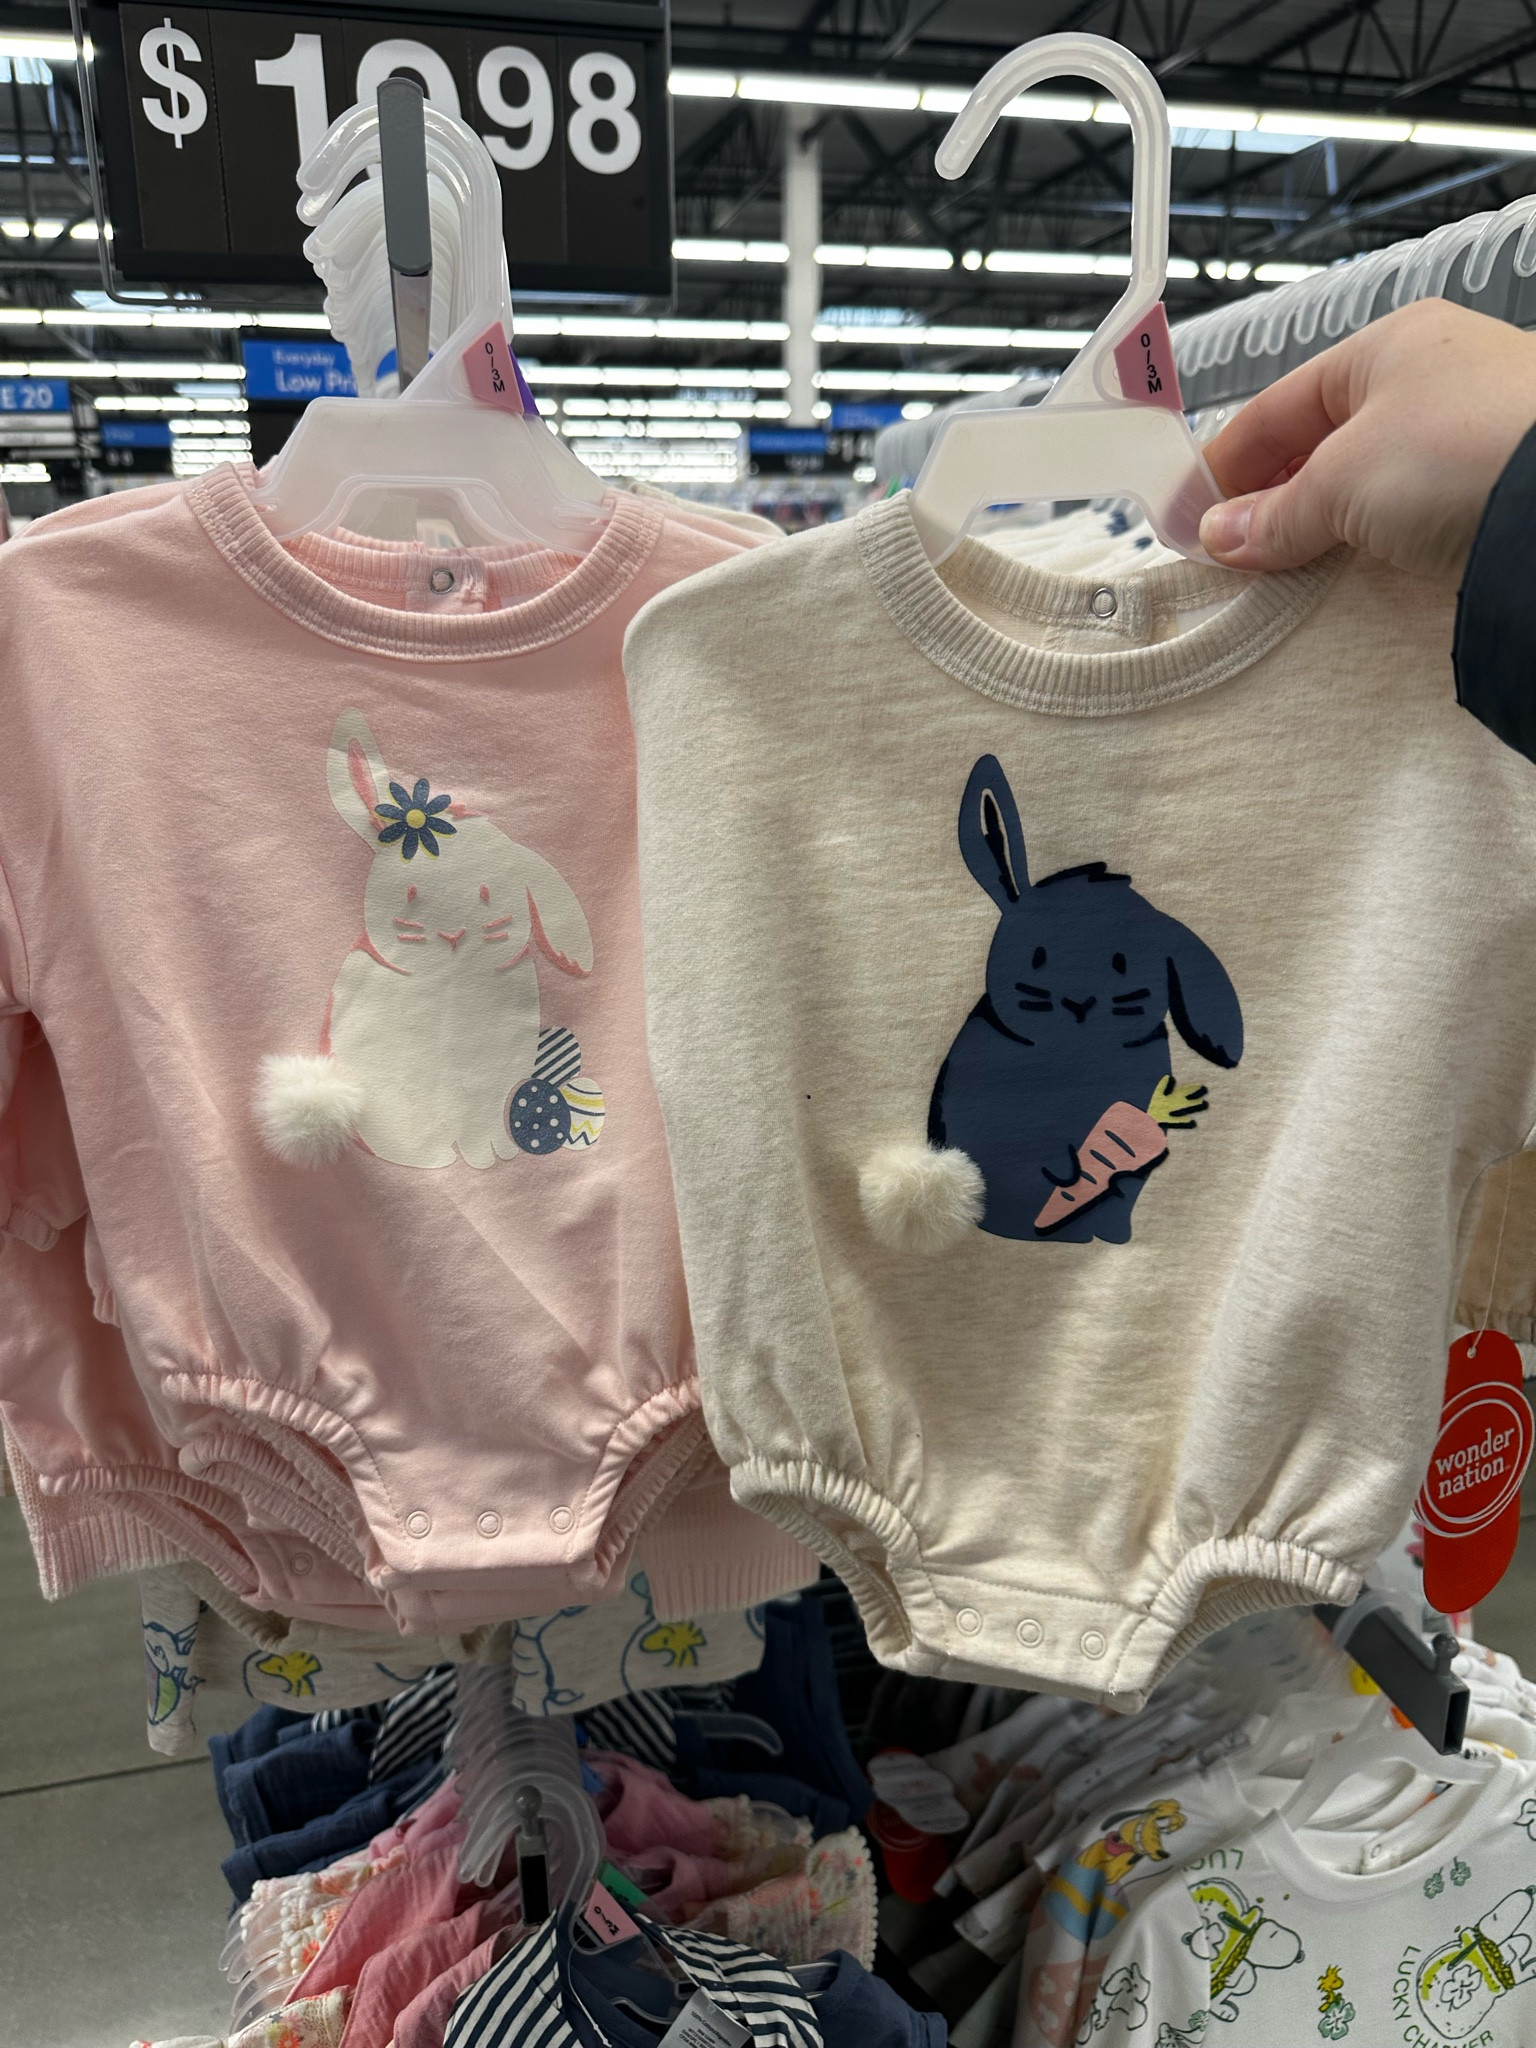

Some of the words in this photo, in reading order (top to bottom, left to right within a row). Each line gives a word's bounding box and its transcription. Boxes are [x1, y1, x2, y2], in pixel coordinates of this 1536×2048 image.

[139, 18, 208, 148] $
[273, 349, 335, 367] Everyday
[1140, 333, 1162, 394] 0/3M
[20, 384, 53, 409] 20
[275, 369, 321, 393] Low
[1435, 1427, 1515, 1475] wonder
[1438, 1456, 1505, 1499] nation
[1184, 1848, 1243, 1870] LUC
[1393, 1945, 1421, 2021] LUCKY
[1403, 2025, 1494, 2048] CHER
